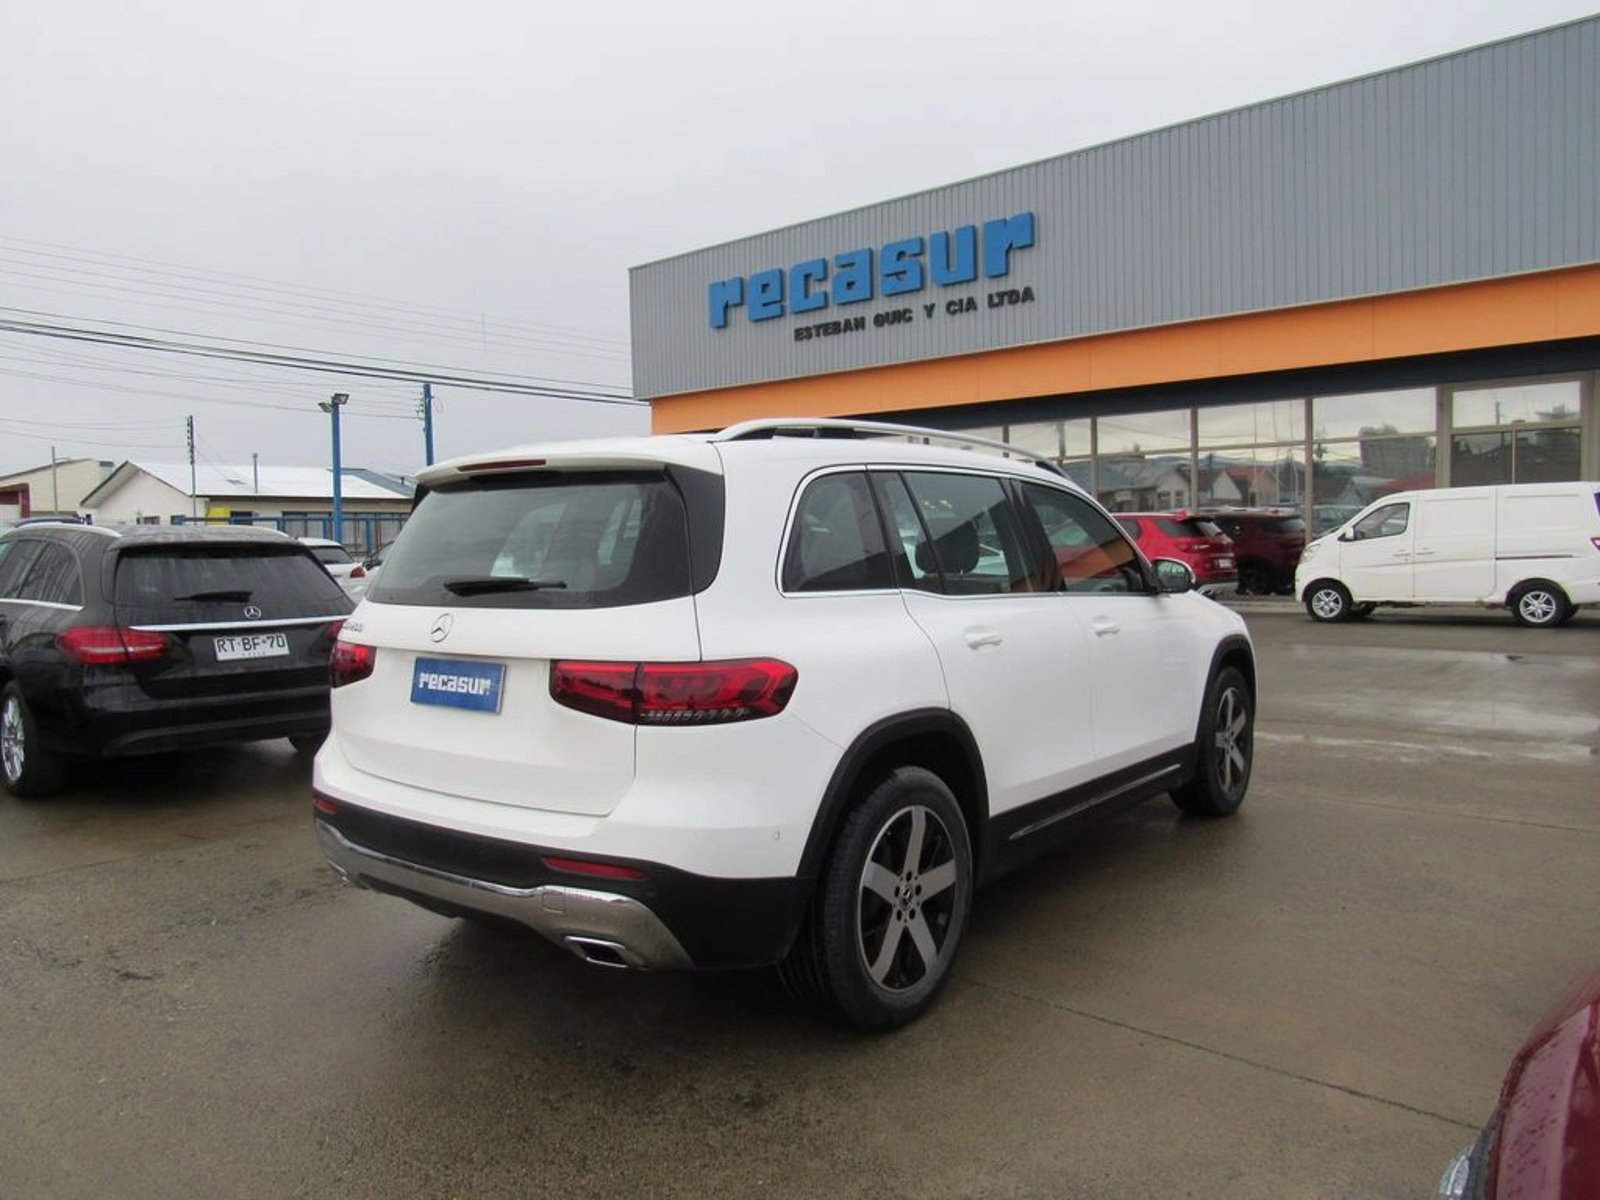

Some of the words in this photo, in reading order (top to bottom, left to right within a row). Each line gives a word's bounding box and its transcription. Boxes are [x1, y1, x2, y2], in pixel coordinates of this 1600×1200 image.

[708, 211, 1036, 329] recasur
[794, 317, 865, 342] ESTEBAN
[923, 303, 936, 319] Y
[945, 296, 977, 316] CIA
[987, 285, 1035, 309] LTDA
